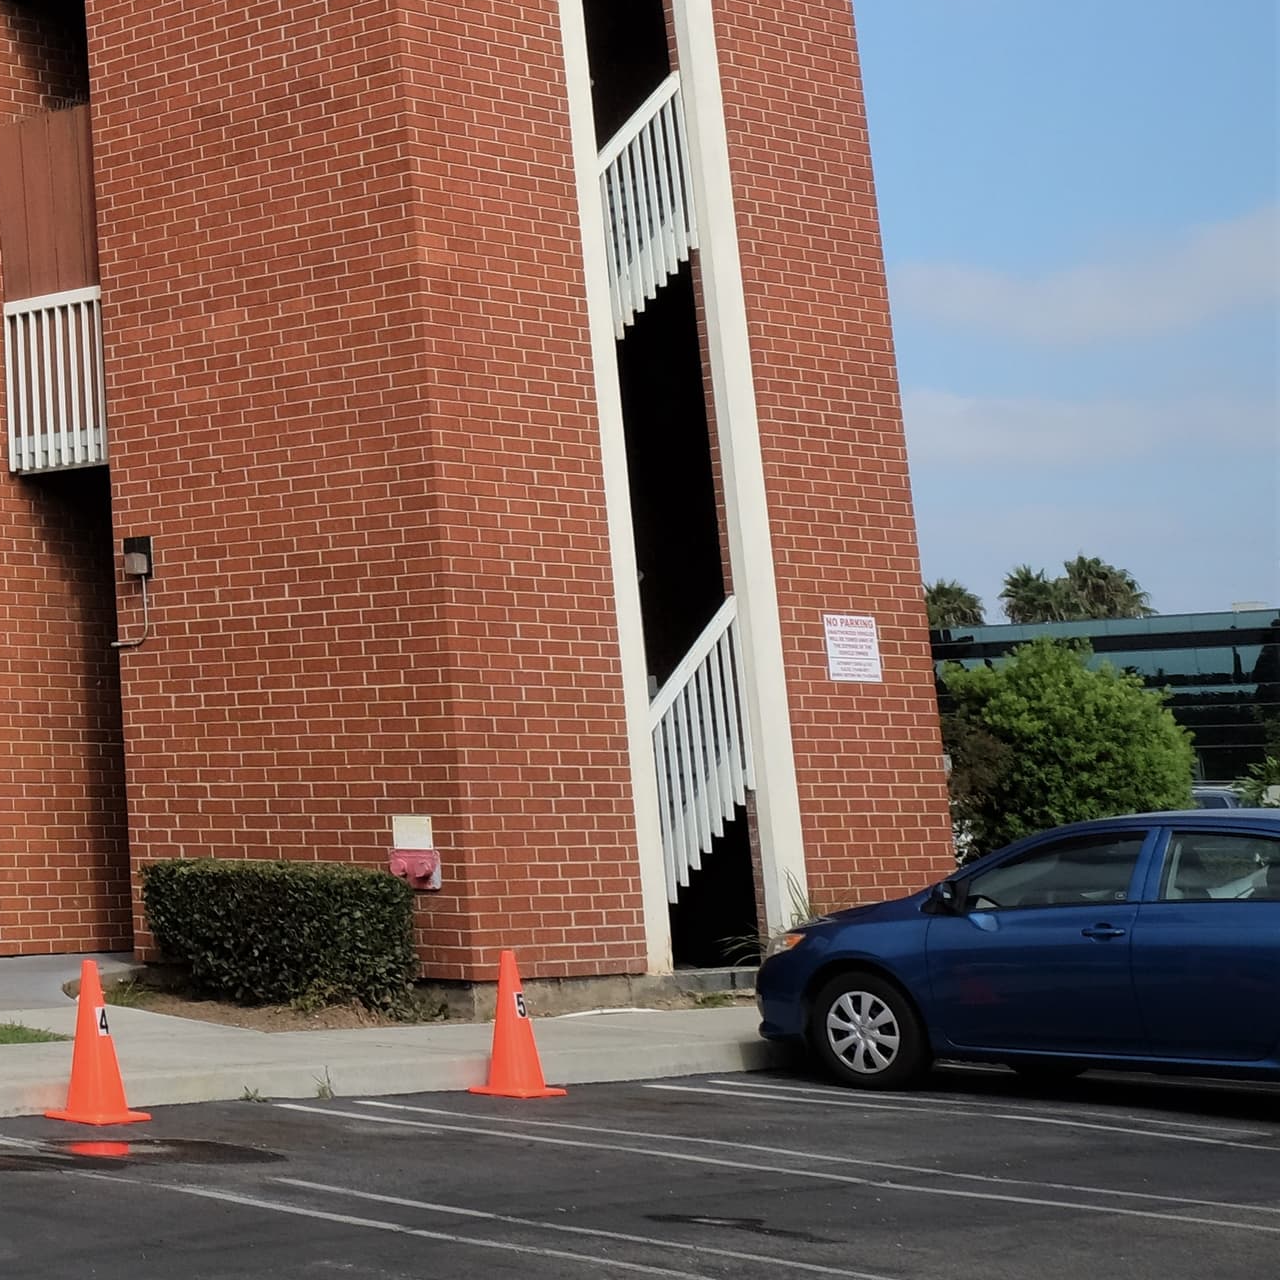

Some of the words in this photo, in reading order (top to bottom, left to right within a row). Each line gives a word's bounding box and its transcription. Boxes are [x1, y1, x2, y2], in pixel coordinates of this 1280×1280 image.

[826, 617, 838, 626] NO
[840, 618, 873, 629] PARKING
[516, 993, 526, 1018] 5
[99, 1008, 109, 1035] 4
